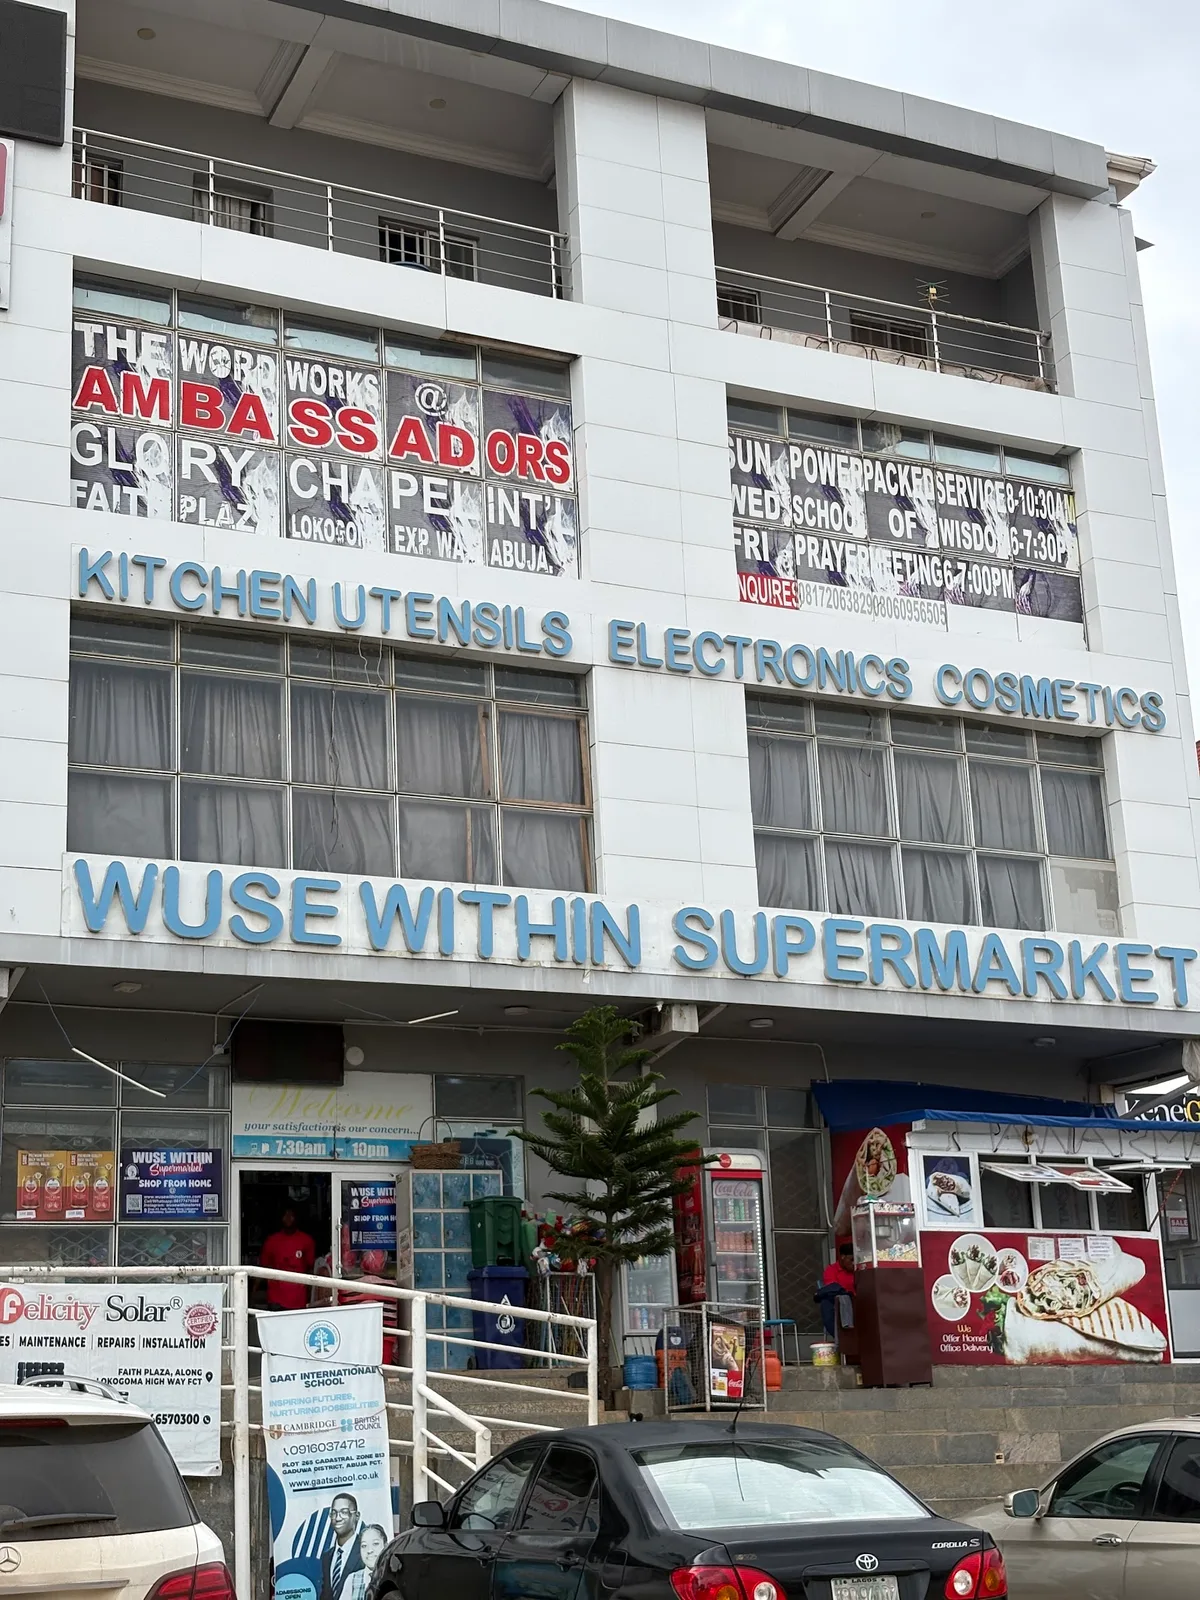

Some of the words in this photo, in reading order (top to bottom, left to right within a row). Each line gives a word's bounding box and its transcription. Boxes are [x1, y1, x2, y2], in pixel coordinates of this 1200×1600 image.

[74, 322, 168, 369] THE
[179, 338, 276, 382] WORD
[286, 358, 380, 405] WORKS
[415, 383, 448, 417] @
[70, 423, 255, 487] GLORY
[289, 457, 478, 521] CHAPEL
[71, 479, 162, 517] FAIT
[179, 494, 268, 533] PLAZ
[437, 531, 473, 564] WA
[793, 494, 866, 538] SCHOO
[888, 508, 917, 540] OF
[939, 518, 1009, 559] WISDO
[1010, 527, 1074, 569] 6-7:30P
[795, 534, 869, 580] PRAYER
[870, 546, 943, 588] MEETING
[943, 562, 1015, 599] 67:00PM
[78, 547, 317, 625] KITCHEN
[331, 581, 574, 658] UTENSILS
[607, 619, 914, 700] ELECTRONICS
[933, 663, 1168, 733] COSMETICS
[73, 857, 343, 946] WUSE
[359, 880, 642, 969] WITHIN
[673, 906, 1199, 1008] SUPERMARKET
[249, 1085, 413, 1120] Welcome
[244, 1122, 271, 1132] your
[272, 1122, 337, 1133] satisfaction
[275, 1139, 326, 1155] 7:30am
[132, 1151, 166, 1163] WUSE
[169, 1151, 213, 1164] WITHIN
[149, 1162, 202, 1176] Supermarket
[139, 1179, 162, 1187] SHOP
[163, 1179, 187, 1187] FROM
[188, 1179, 212, 1187] HOME
[351, 1187, 375, 1197] WUSE
[371, 1214, 389, 1222] FROM
[3, 1288, 99, 1331] Felicity
[957, 1324, 972, 1333] We
[19, 1336, 86, 1348] MAINTENANCE
[97, 1337, 135, 1348] REPAIRS
[142, 1338, 206, 1349] INSTALLATION
[942, 1333, 960, 1343] Offer
[940, 1343, 961, 1352] Office
[962, 1343, 993, 1354] Delivery
[118, 1368, 142, 1377] FAITH
[144, 1368, 173, 1378] PLAZA,
[175, 1368, 203, 1377] ALONG
[269, 1373, 298, 1384] GAAT
[300, 1366, 377, 1381] INTERNATIONAL
[97, 1378, 143, 1386] OKOGOMA
[145, 1378, 164, 1386] HIGH
[166, 1378, 185, 1386] WAY
[187, 1378, 202, 1386] FCT
[304, 1378, 345, 1388] SCHOOL
[269, 1396, 312, 1408] INSPIRING
[313, 1393, 356, 1404] FUTURES,
[269, 1406, 321, 1418] NURTURING
[321, 1400, 380, 1413] POSSIBILITIES
[283, 1419, 337, 1432] CAMBRIDGE
[354, 1416, 380, 1425] BRITISH
[354, 1423, 382, 1431] COUNCIL
[289, 1438, 366, 1456] 09160374712
[315, 1455, 355, 1465] CADASTRAL
[282, 1467, 312, 1475] GADUWA
[346, 1461, 368, 1469] ABUJA
[289, 1471, 379, 1488] www.gaatschool.co.uk
[931, 1541, 968, 1550] COROLLA
[969, 1538, 981, 1548] S
